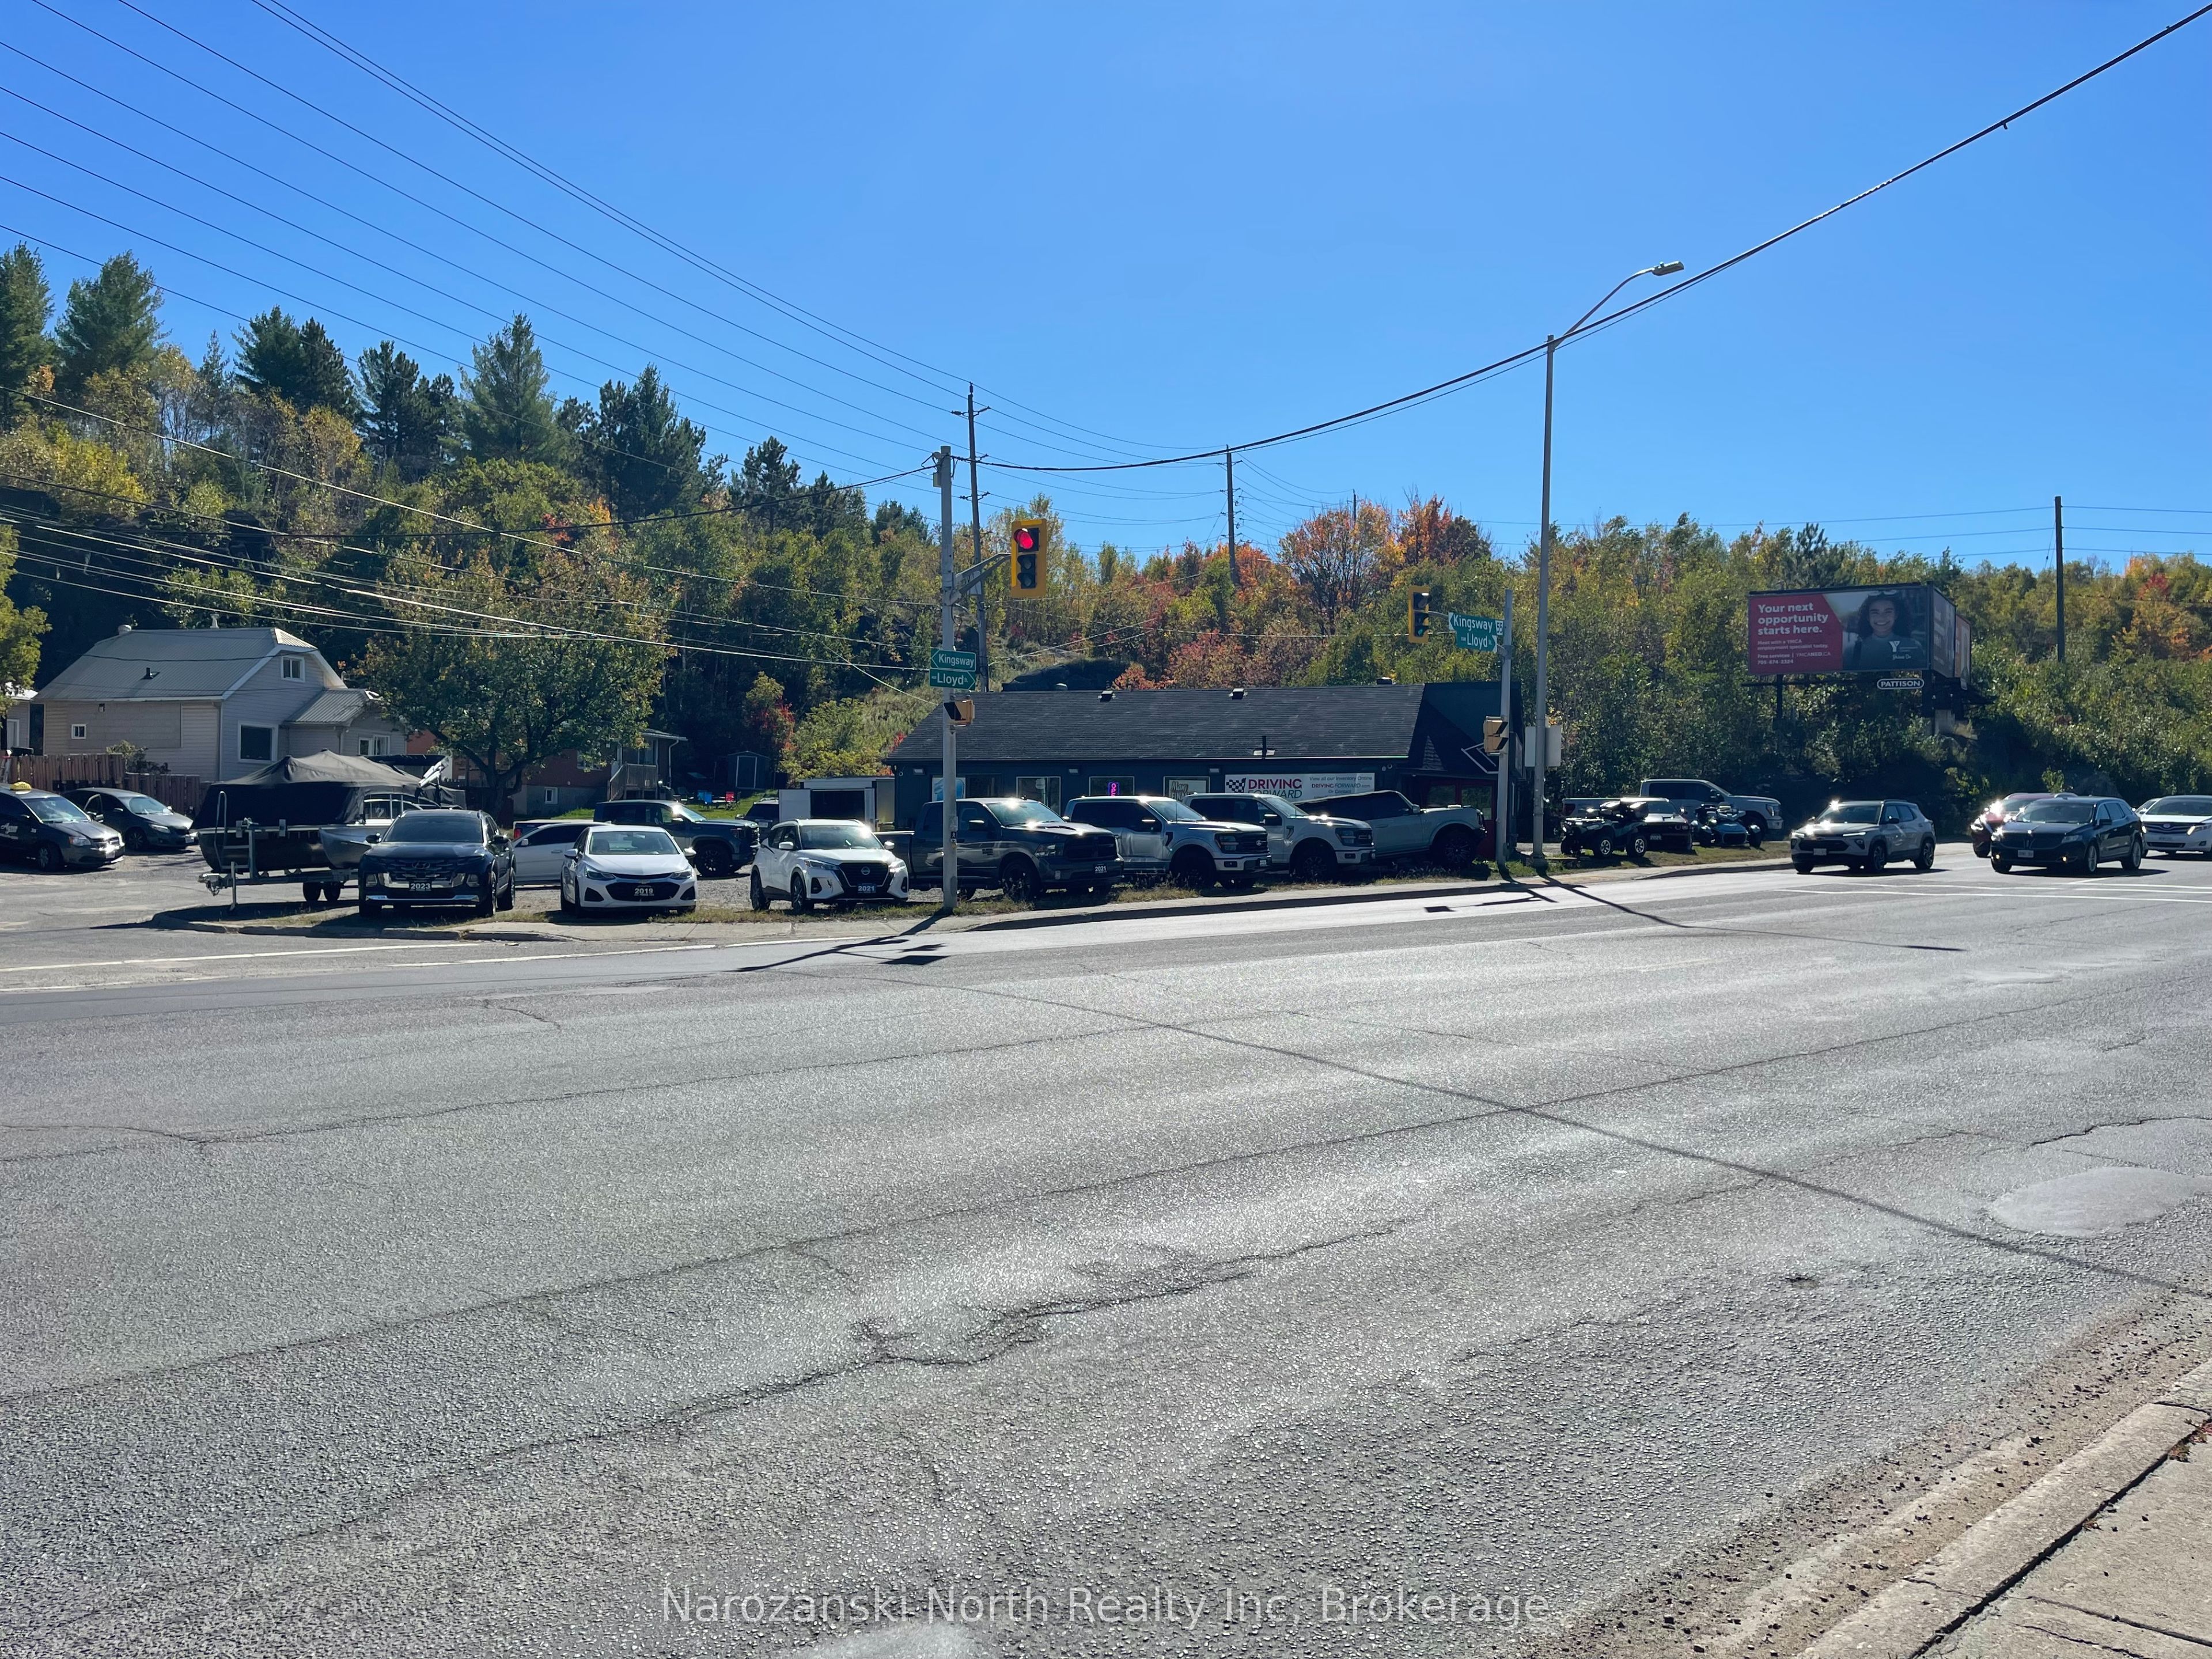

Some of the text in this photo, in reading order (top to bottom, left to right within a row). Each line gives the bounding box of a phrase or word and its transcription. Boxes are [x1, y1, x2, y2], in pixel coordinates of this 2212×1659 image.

[1758, 603, 1814, 613] Your next
[1453, 614, 1493, 634] Kingsway
[1758, 612, 1829, 626] opportunity
[1758, 625, 1823, 635] starts here.
[1467, 633, 1488, 650] Lloyd
[938, 654, 974, 668] Kingsway
[937, 672, 964, 687] Lloyd
[1248, 778, 1302, 789] DRIVING
